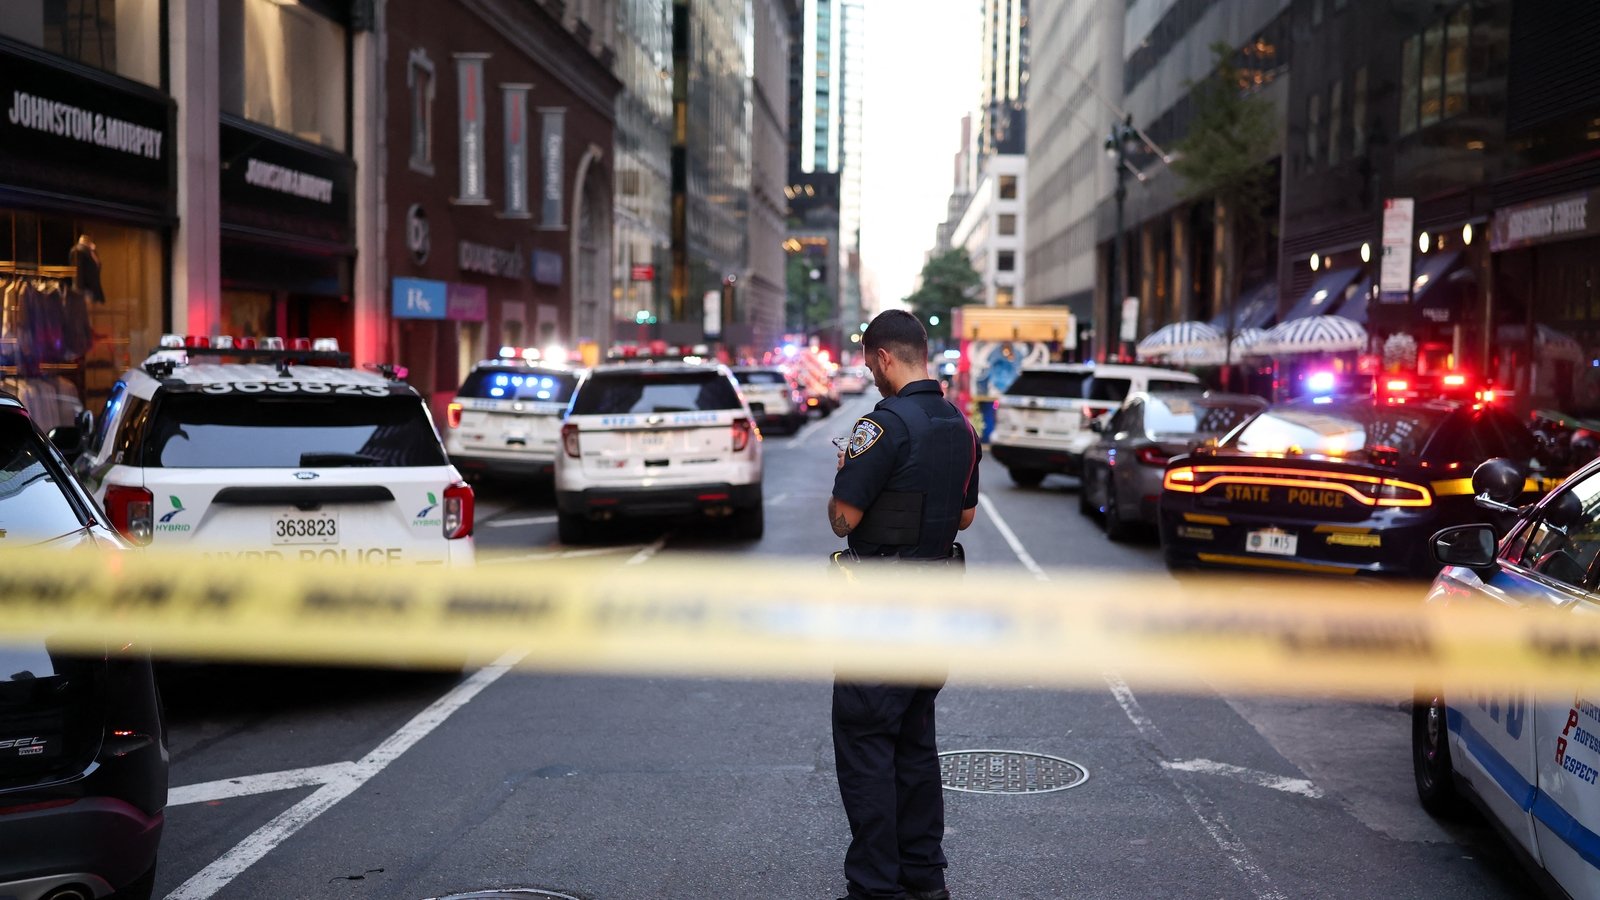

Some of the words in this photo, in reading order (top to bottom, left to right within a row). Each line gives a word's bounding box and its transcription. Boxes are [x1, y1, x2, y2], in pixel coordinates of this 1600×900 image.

[495, 375, 554, 389] NYPD
[1225, 484, 1270, 502] STATE
[1288, 487, 1345, 508] POLICE
[155, 523, 191, 532] HYBRID
[276, 519, 336, 537] 363823
[412, 519, 442, 528] HYBRID
[1555, 736, 1599, 785] RESPECT
